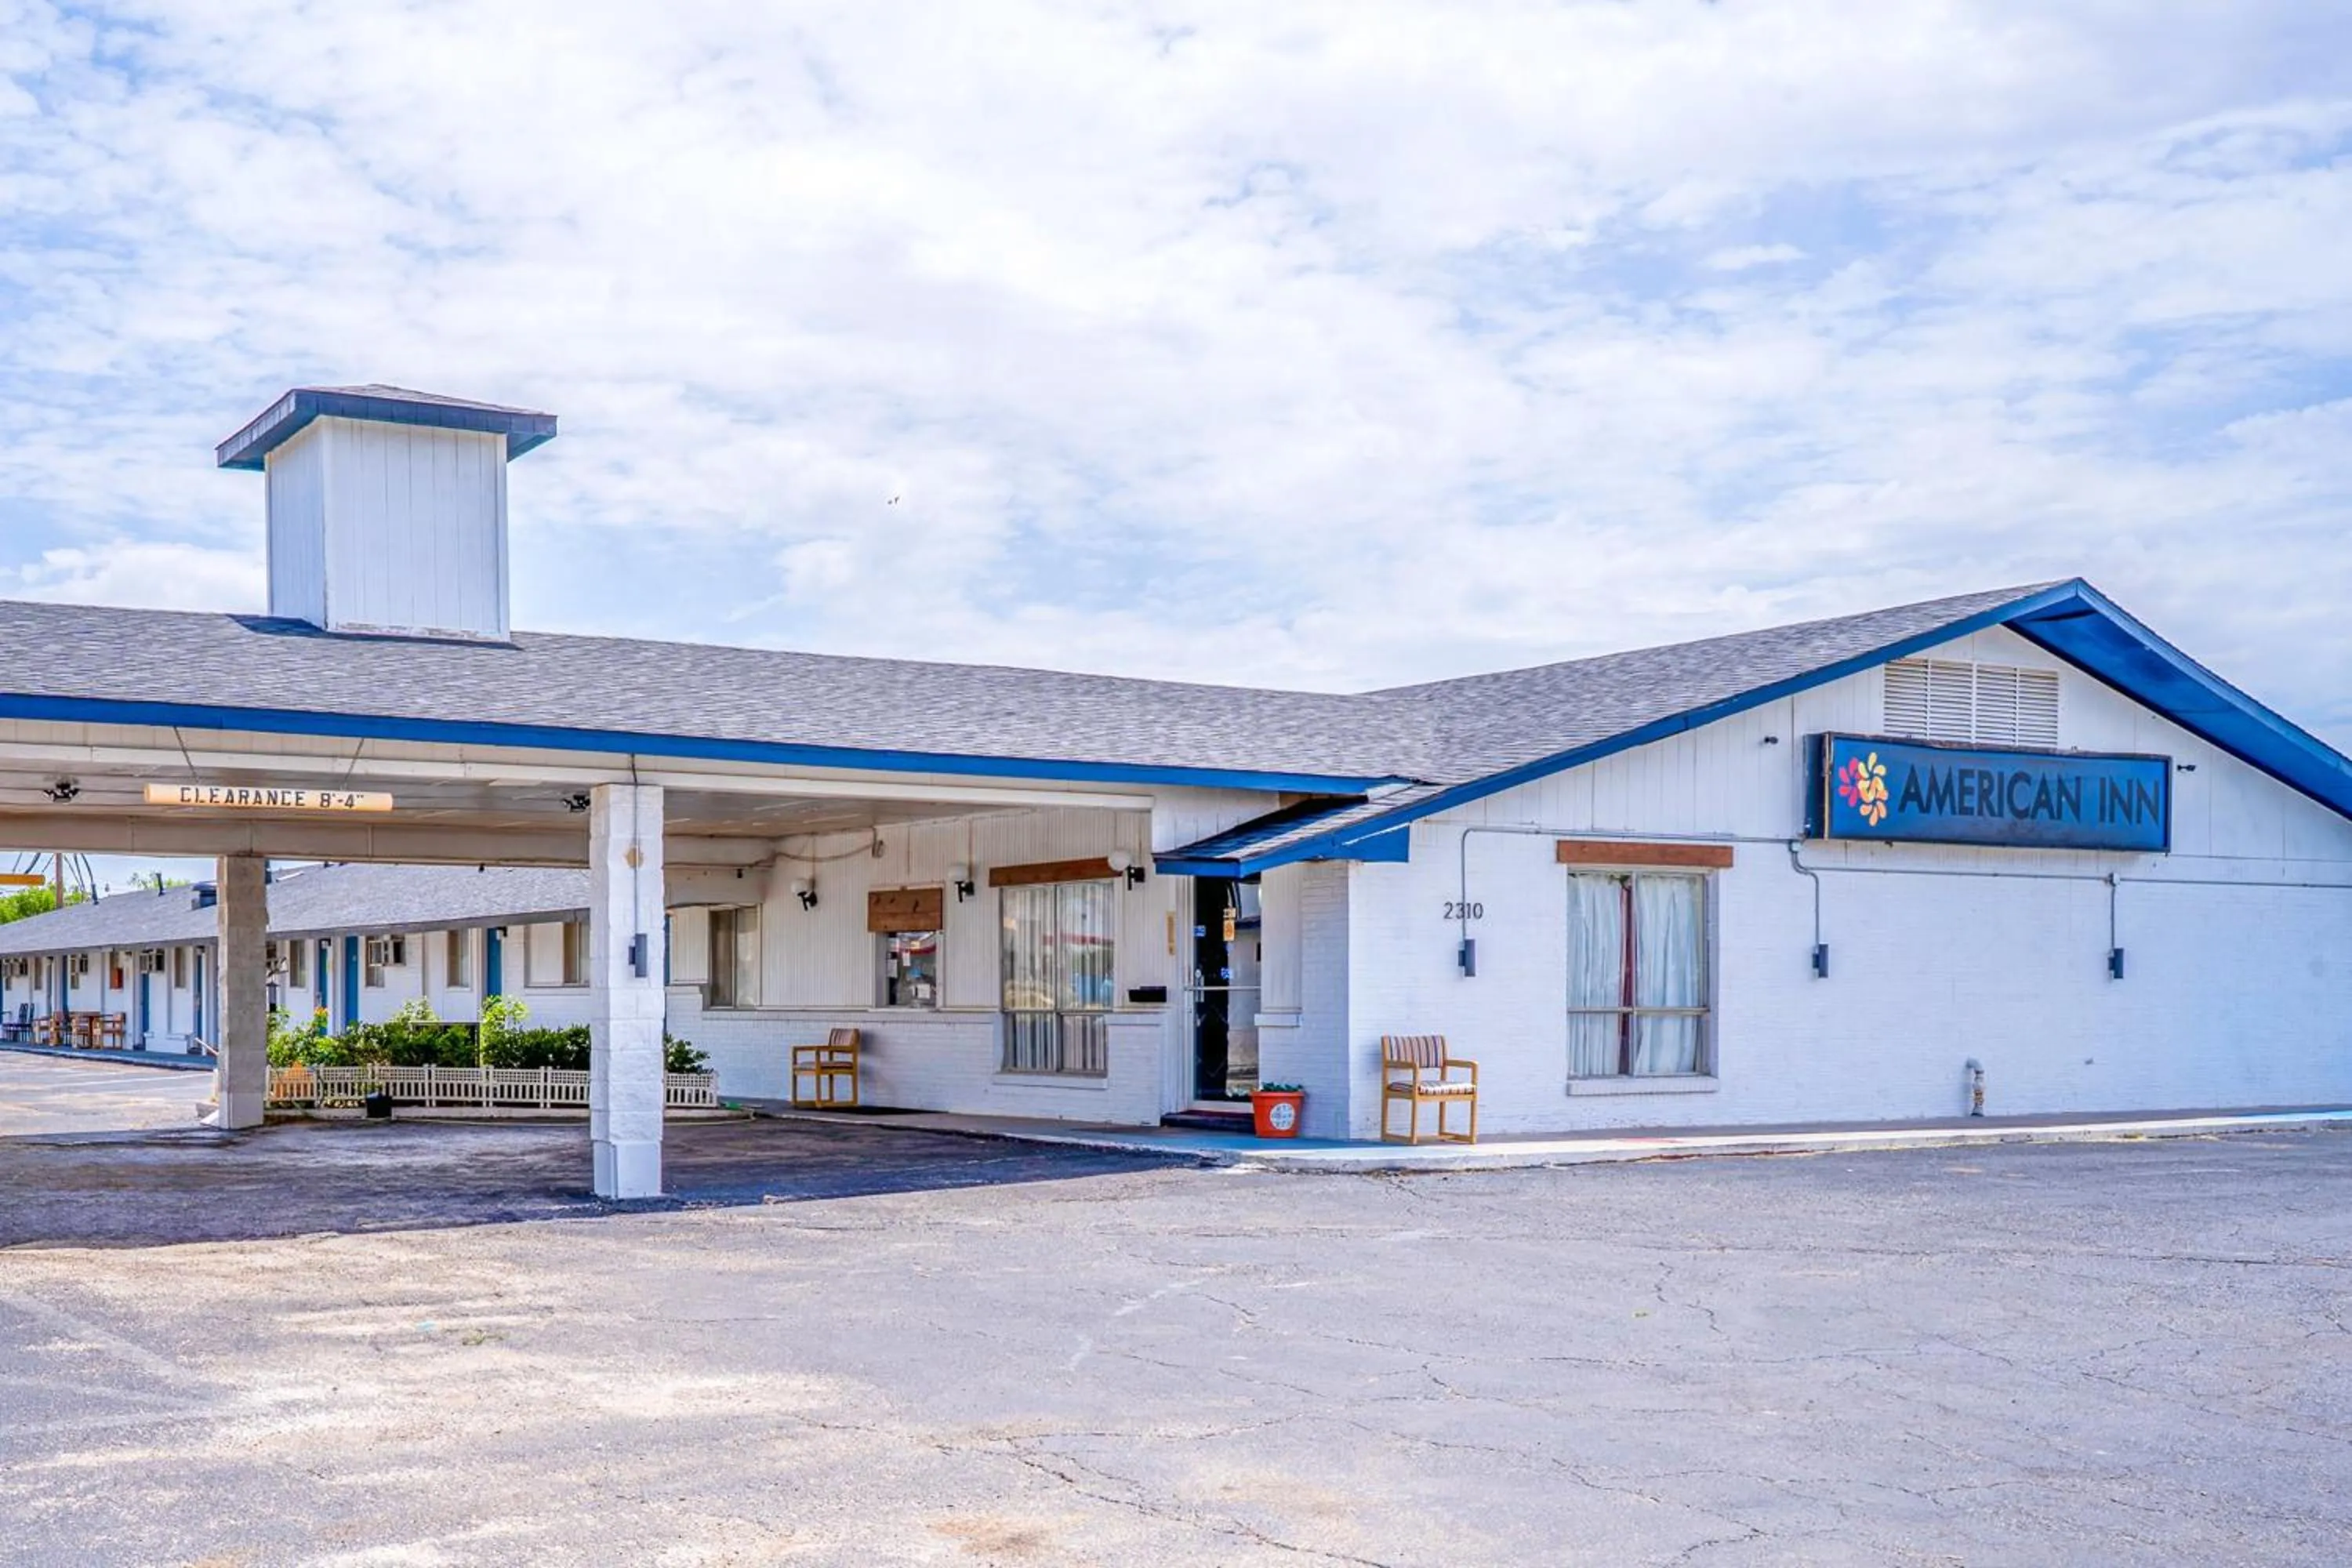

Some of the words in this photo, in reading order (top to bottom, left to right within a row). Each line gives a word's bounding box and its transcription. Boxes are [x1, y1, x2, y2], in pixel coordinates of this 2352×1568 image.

[180, 786, 305, 807] CLEARANCE
[1898, 764, 2082, 824] AMERICAN
[2099, 775, 2159, 826] INN
[1443, 902, 1483, 920] 2310
